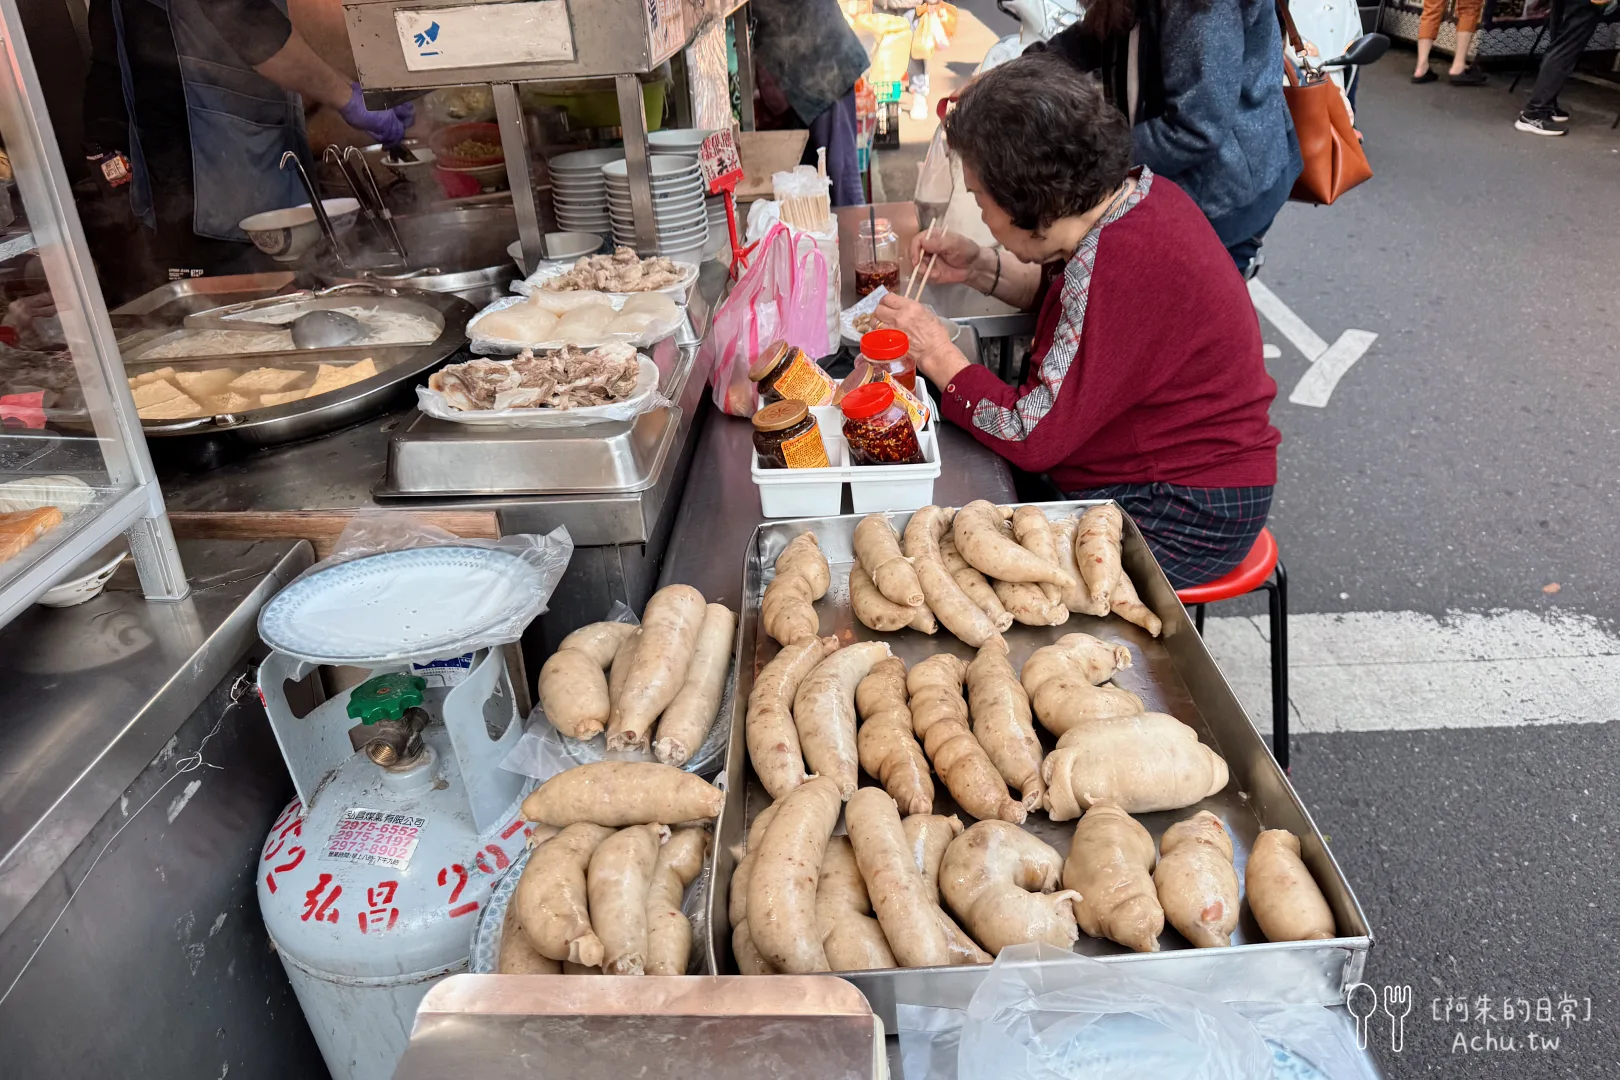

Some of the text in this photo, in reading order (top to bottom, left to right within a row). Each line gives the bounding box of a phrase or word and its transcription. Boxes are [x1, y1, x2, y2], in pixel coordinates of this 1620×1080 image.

[340, 820, 419, 838] 2975-6552
[334, 830, 413, 848] 2975-2197
[328, 840, 408, 859] 2973-8902
[300, 873, 400, 935] 弘昌
